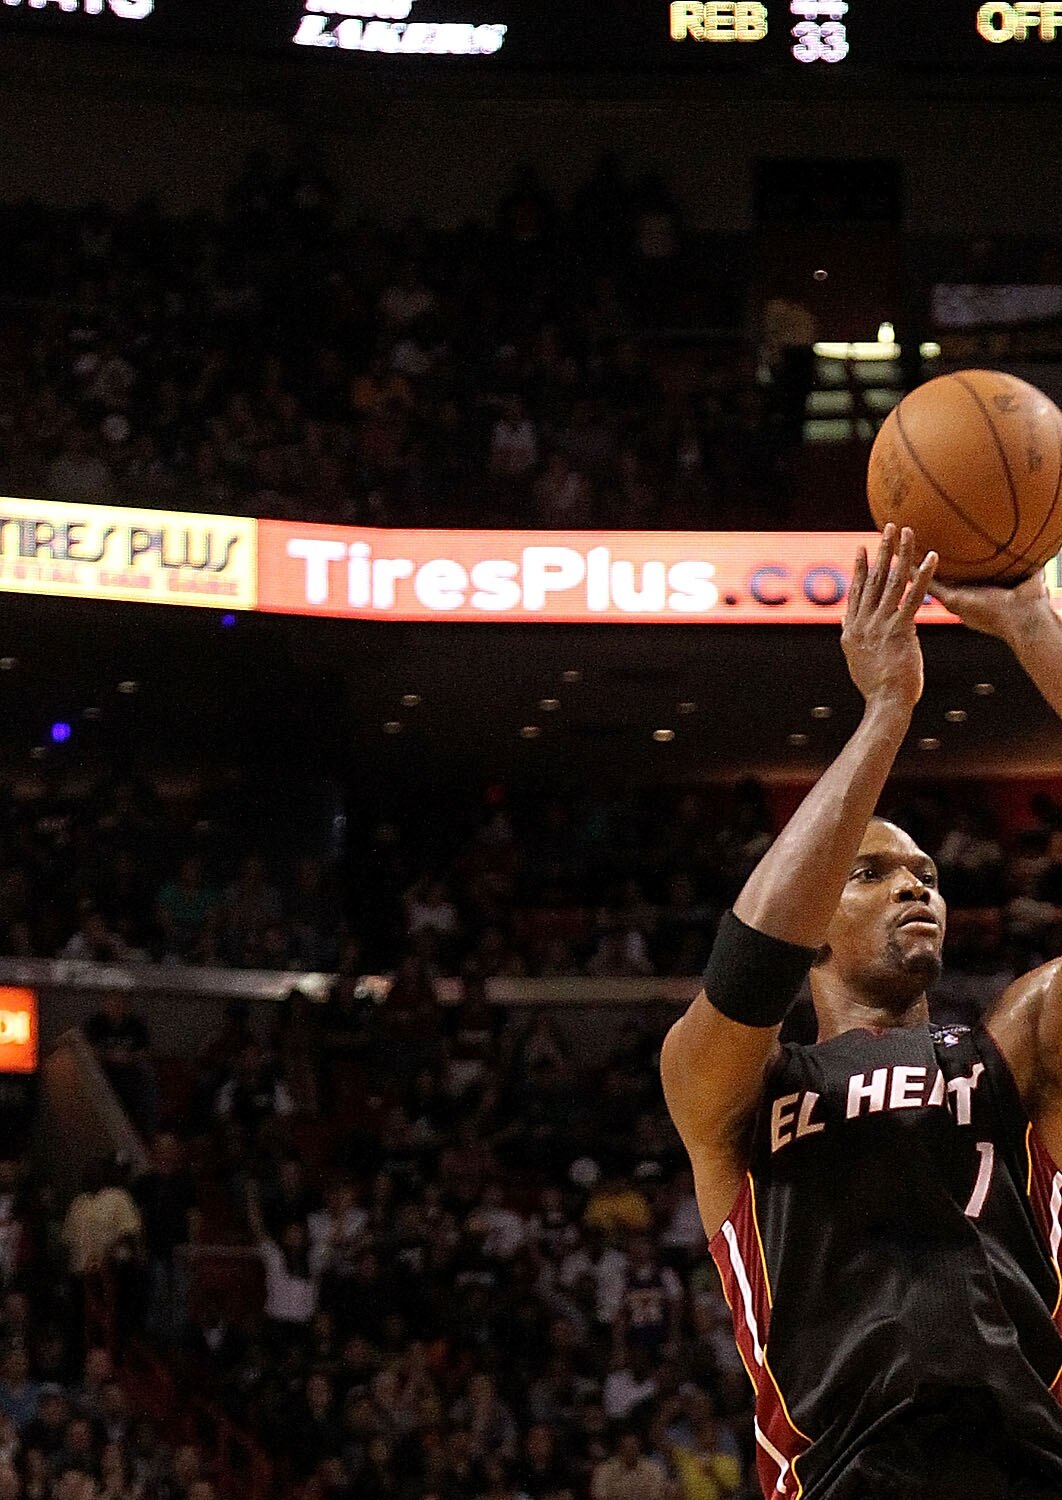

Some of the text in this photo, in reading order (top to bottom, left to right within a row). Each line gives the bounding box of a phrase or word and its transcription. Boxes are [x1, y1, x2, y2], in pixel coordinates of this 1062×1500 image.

[670, 1, 768, 42] REB
[791, 21, 850, 63] 33
[128, 526, 238, 572] PLUS
[287, 537, 930, 612] TiresPlus.co
[771, 1090, 826, 1154] EL
